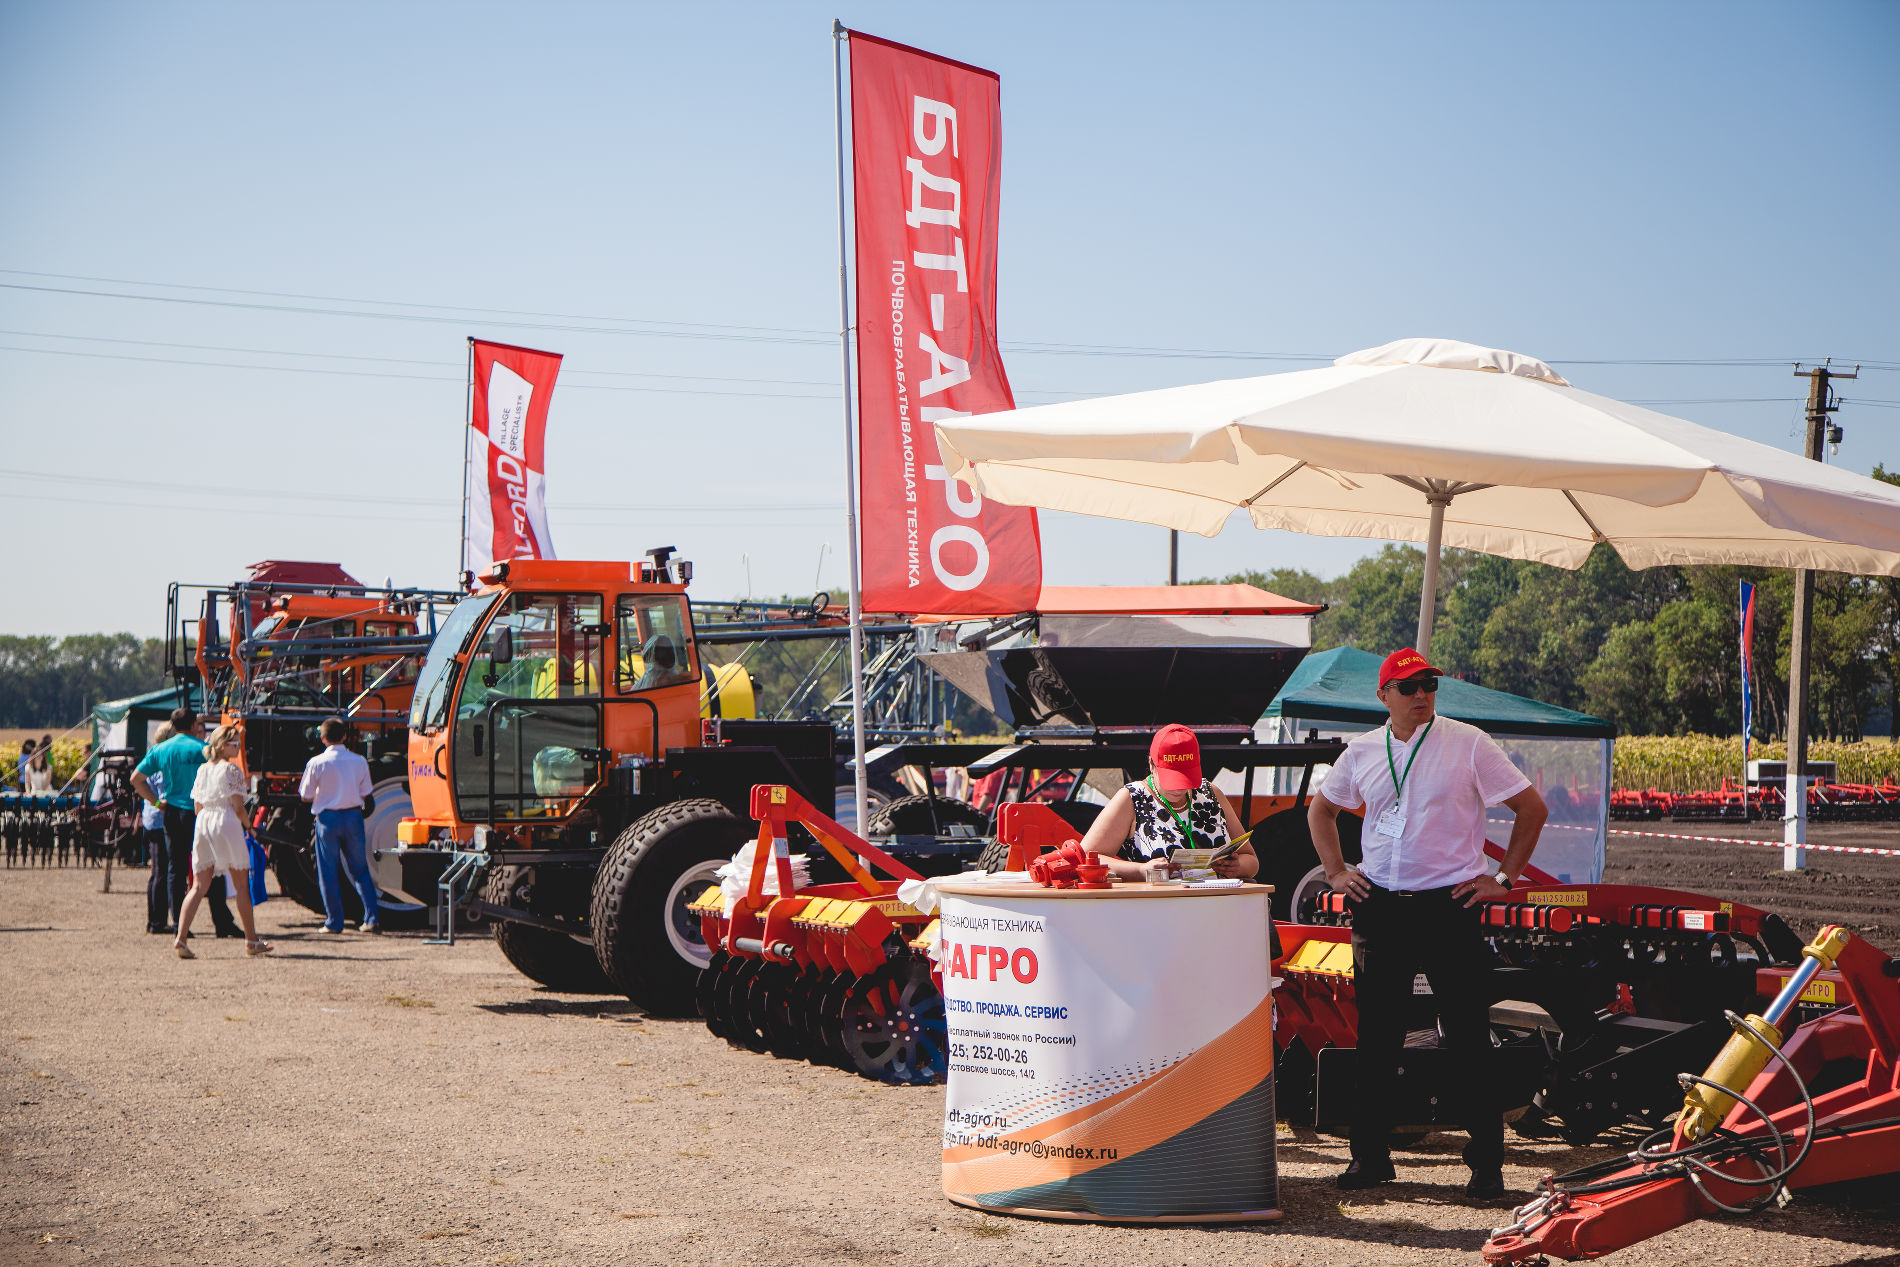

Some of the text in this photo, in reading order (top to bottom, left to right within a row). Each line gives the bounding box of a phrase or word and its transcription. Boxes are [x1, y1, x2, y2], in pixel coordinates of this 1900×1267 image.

[500, 407, 511, 445] TILLAGE
[891, 260, 920, 589] ПОЧВООБРАБАТЫВАЮЩАЯ ТЕХНИКА
[1163, 753, 1194, 763] БДТ-АГРО
[877, 903, 907, 912] ОРТЕС
[991, 918, 1044, 933] ТЕХНИКА
[976, 1001, 1022, 1018] ПРОДАЖА.
[1024, 1005, 1068, 1020] СЕРВИС
[992, 1031, 1020, 1042] звонок
[1022, 1034, 1033, 1043] по
[1035, 1033, 1077, 1047] России)
[972, 1044, 1028, 1064] 252-00-26
[990, 1067, 1018, 1079] шоссе,
[1019, 1068, 1036, 1080] 14/2
[947, 1108, 1007, 1128] dt-agro.ru
[977, 1133, 1118, 1160] bdt-agro@yandex.ru
